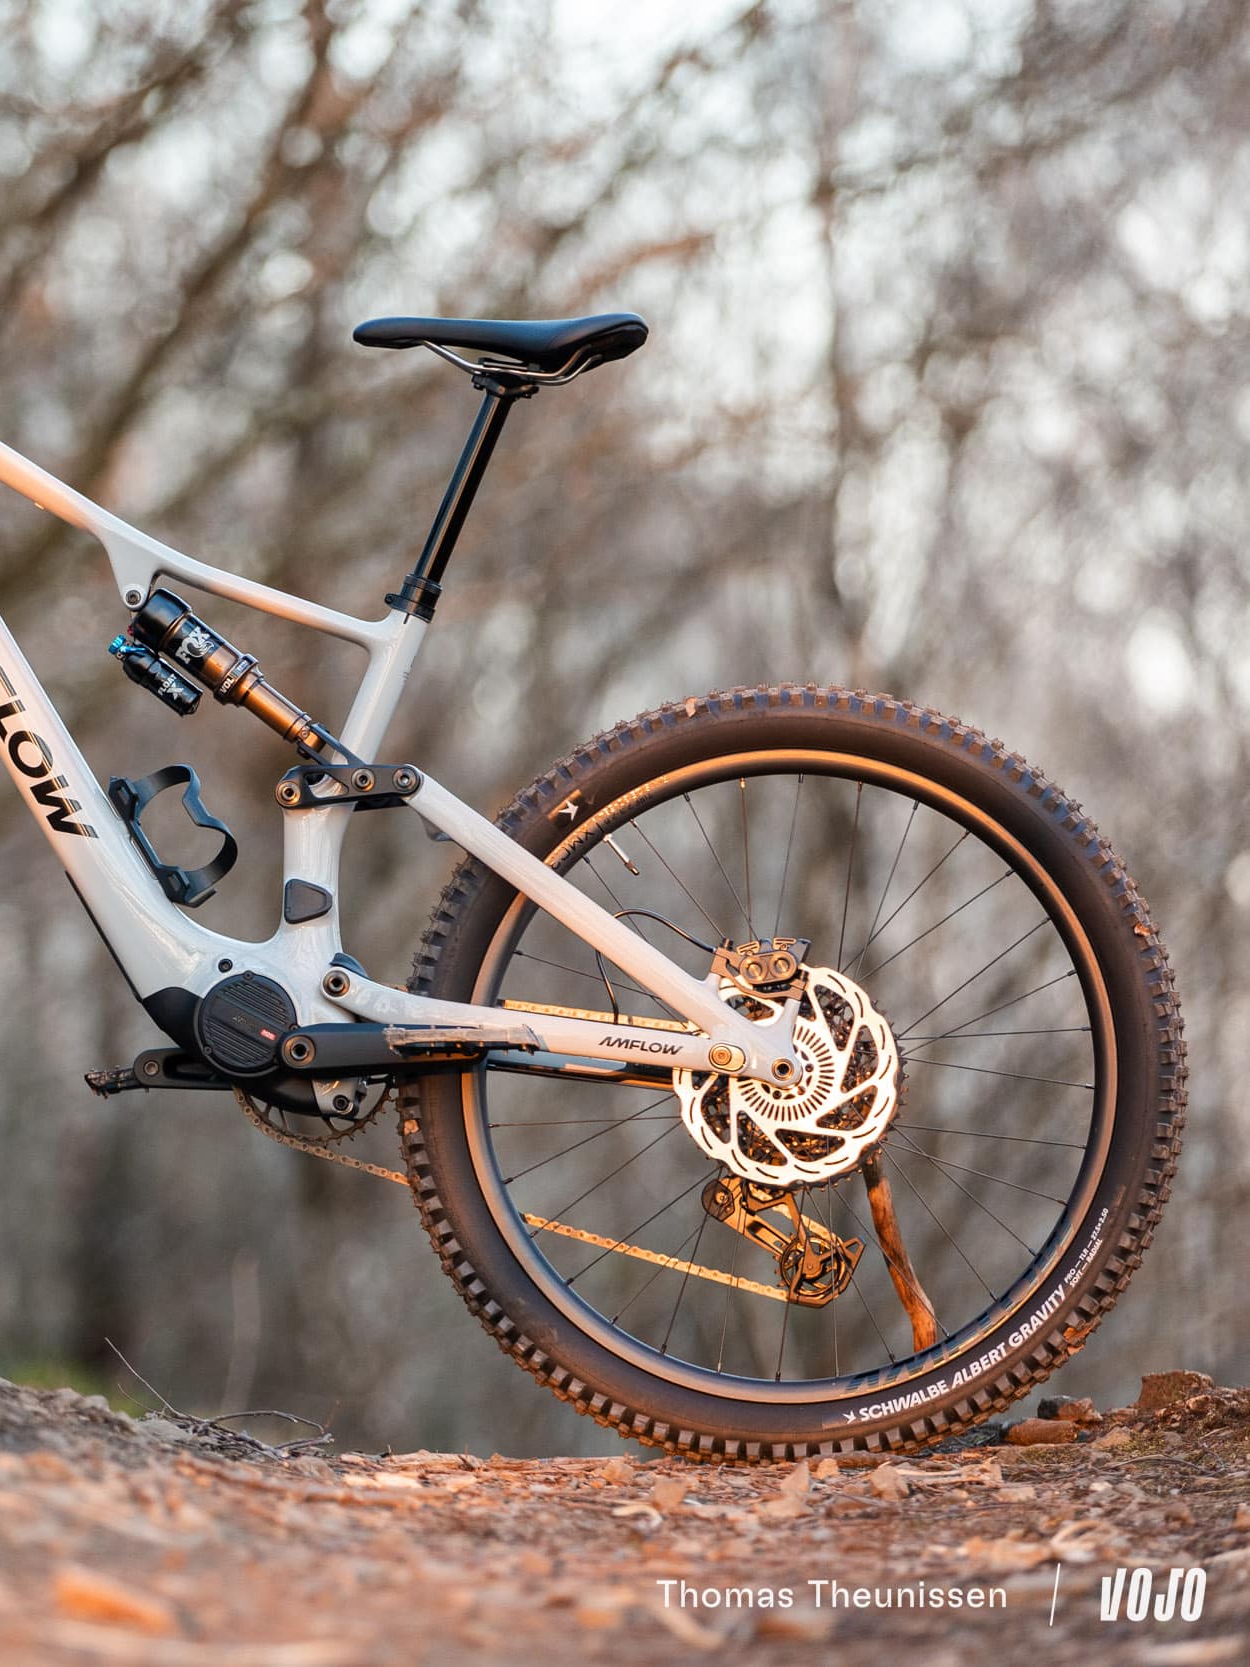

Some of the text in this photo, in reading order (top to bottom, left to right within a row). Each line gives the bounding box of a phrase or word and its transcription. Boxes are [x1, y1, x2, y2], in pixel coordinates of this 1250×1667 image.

[175, 626, 214, 664] FOX
[158, 673, 177, 696] FLOAT
[598, 1036, 683, 1055] AMFLOW
[1064, 1269, 1076, 1283] PRO
[1079, 1247, 1089, 1261] TLR
[1069, 1271, 1083, 1287] SOFT
[1086, 1239, 1102, 1263] RADIAL
[859, 1284, 1066, 1422] SCHWALBE ALBERT GRAVITY
